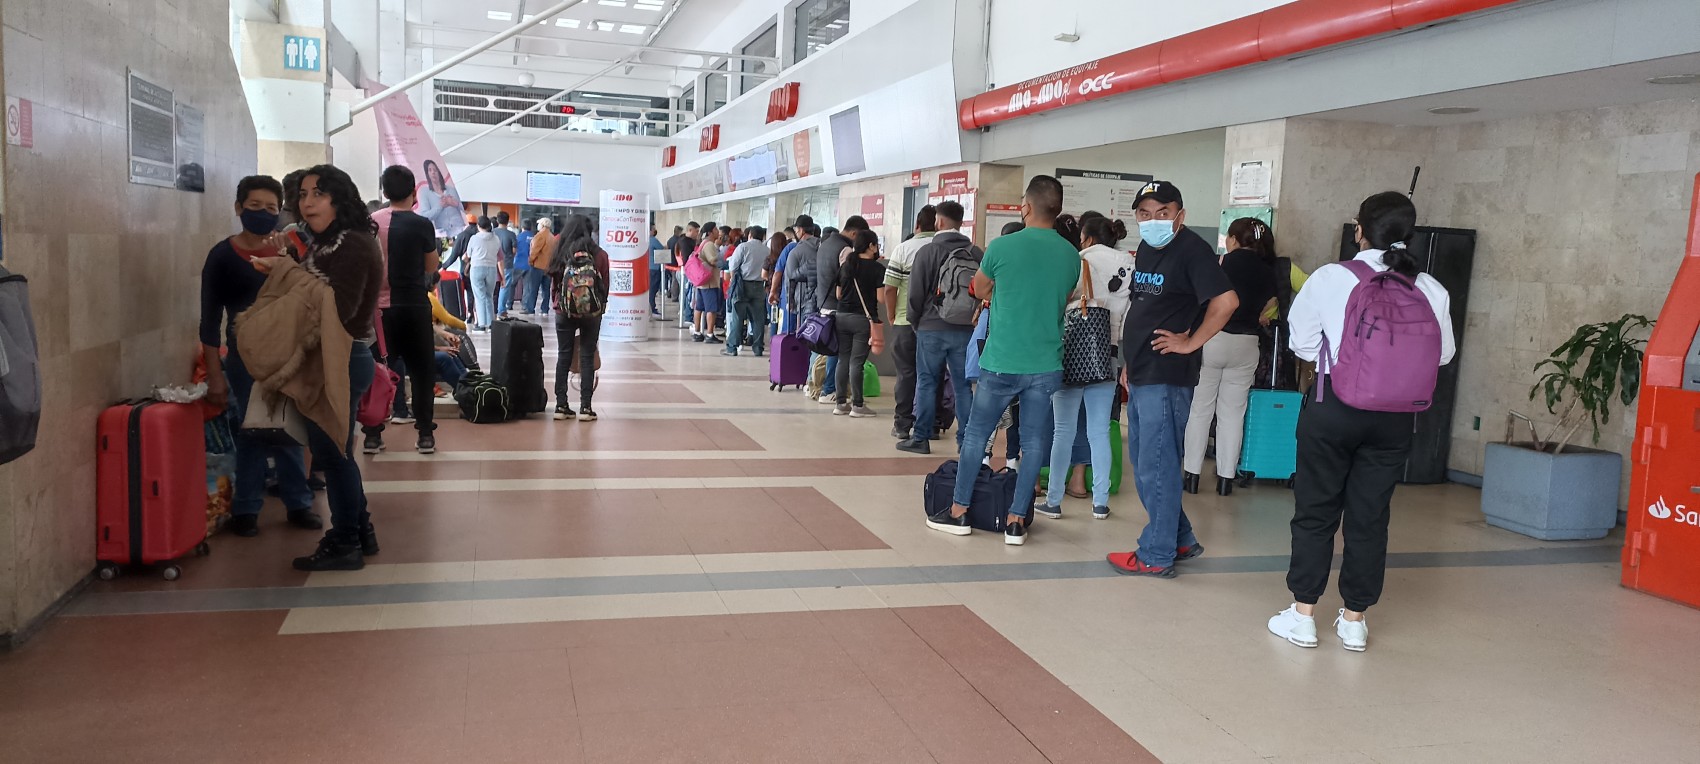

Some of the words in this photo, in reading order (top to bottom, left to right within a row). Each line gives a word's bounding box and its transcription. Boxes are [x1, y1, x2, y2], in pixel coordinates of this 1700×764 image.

[1061, 68, 1071, 78] DE
[1140, 183, 1161, 196] CAT
[606, 230, 639, 244] 50%
[1674, 504, 1700, 527] Sa
